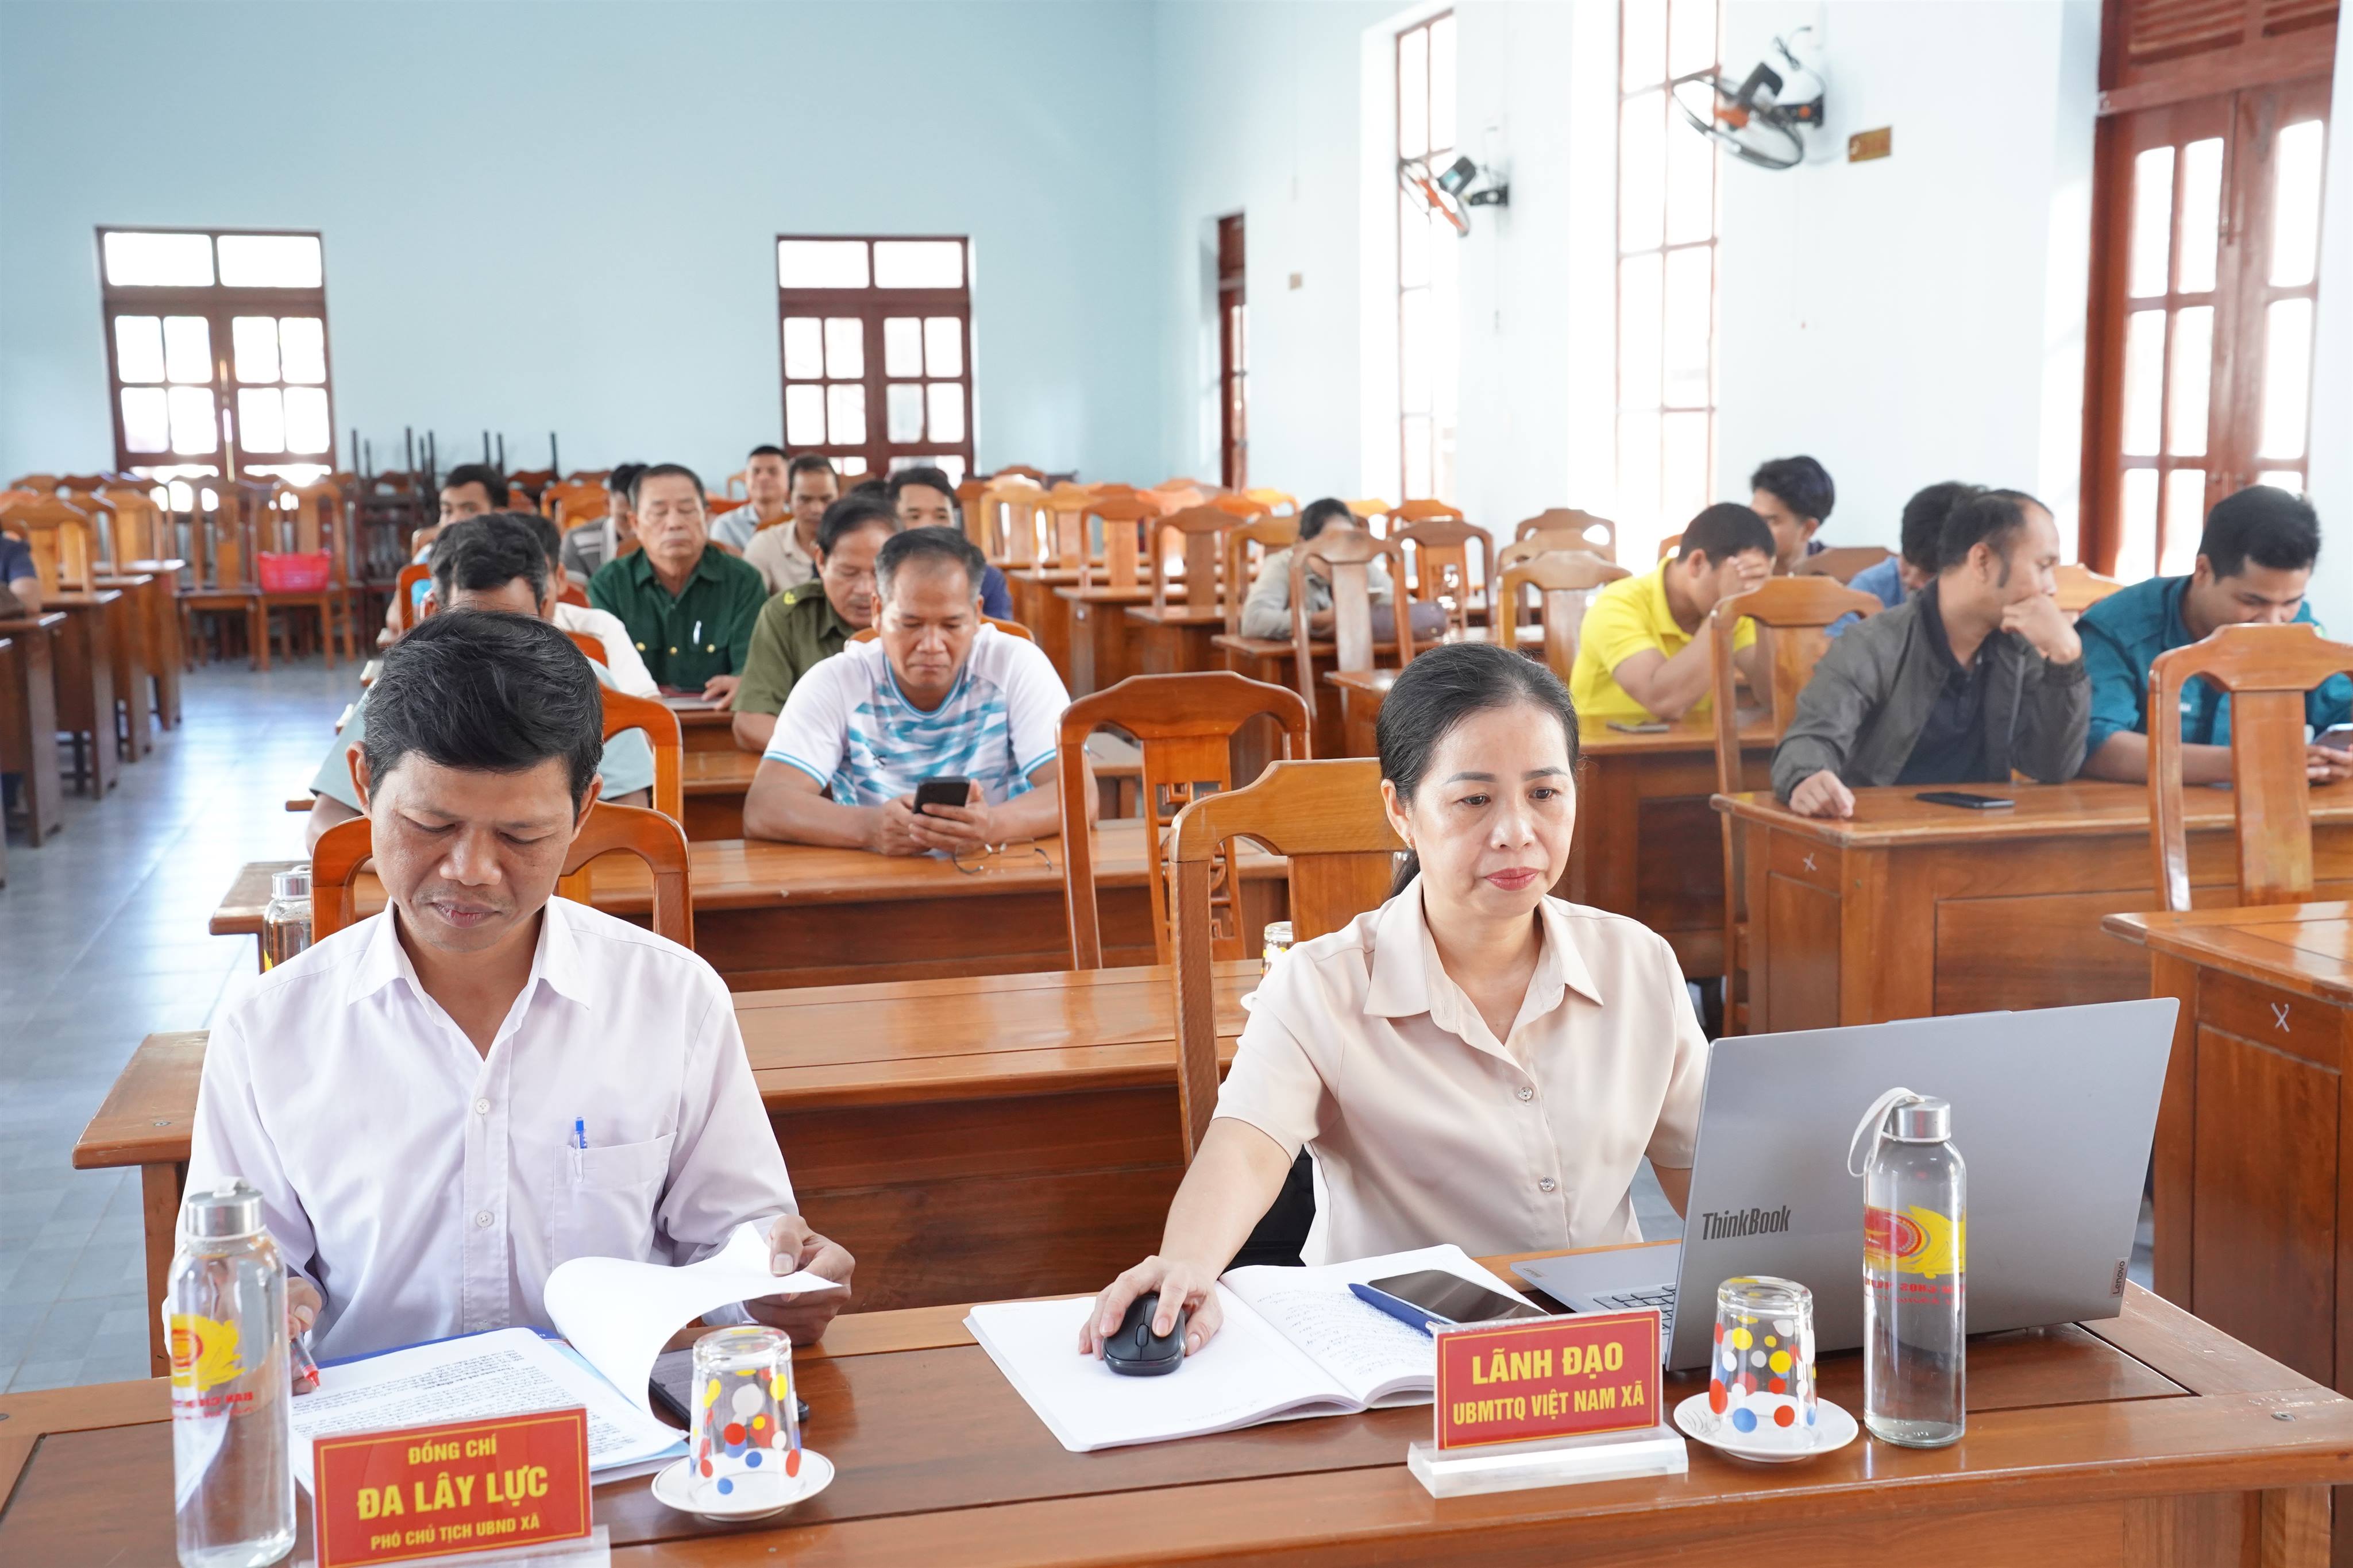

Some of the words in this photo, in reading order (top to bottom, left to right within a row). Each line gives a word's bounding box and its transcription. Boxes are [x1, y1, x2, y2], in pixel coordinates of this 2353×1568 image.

[1702, 1205, 1791, 1240] ThinkBook
[2112, 1261, 2126, 1294] Lenovo
[1472, 1347, 1552, 1385] LÃNH
[1561, 1342, 1623, 1380] ĐẠO
[1453, 1396, 1526, 1425] UBMTTQ
[1531, 1388, 1569, 1420] VIỆT
[1574, 1387, 1615, 1412] NAM
[1621, 1380, 1645, 1407] XÃ
[465, 1434, 496, 1458] CHÍ
[357, 1485, 404, 1520] ĐA
[415, 1472, 475, 1512] LÂY
[486, 1465, 548, 1507] LỰC
[371, 1530, 401, 1550] PHÓ
[439, 1523, 472, 1543] TỊCH
[476, 1517, 516, 1536] UBND
